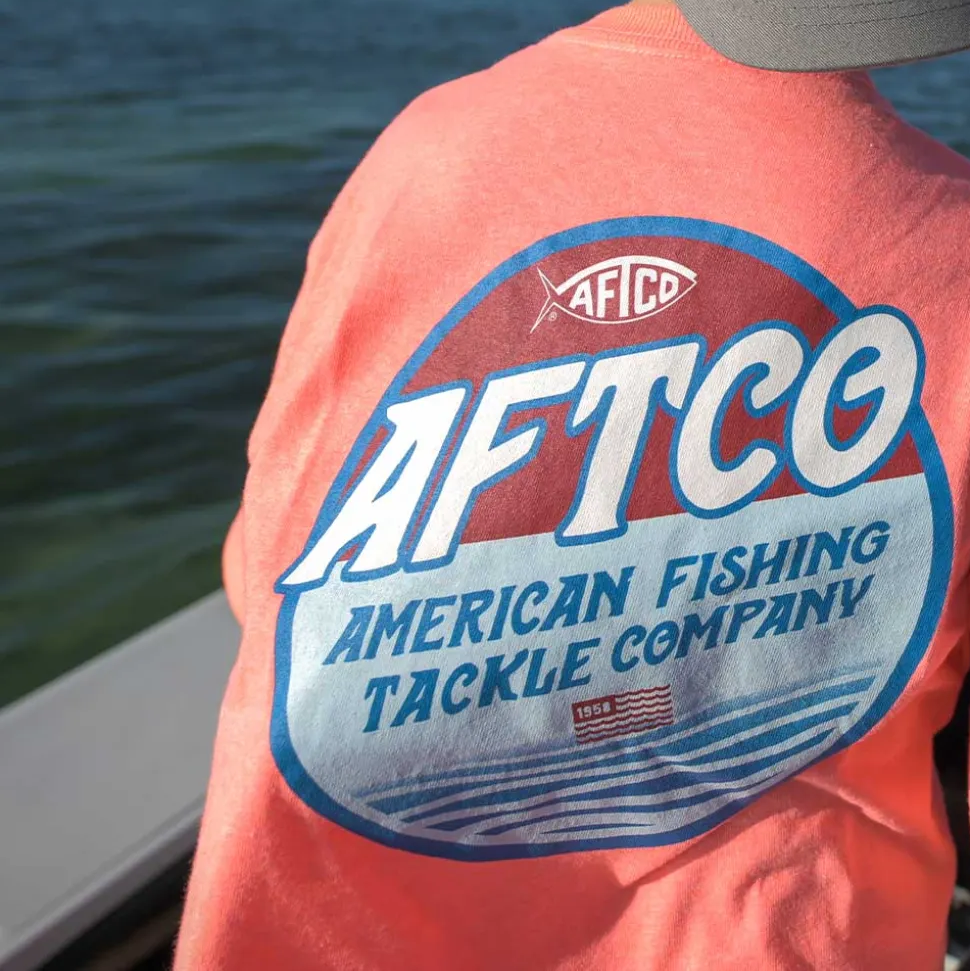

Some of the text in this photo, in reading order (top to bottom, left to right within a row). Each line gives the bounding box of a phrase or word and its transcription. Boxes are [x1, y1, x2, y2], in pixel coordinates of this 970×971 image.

[568, 256, 680, 318] AFTCO
[280, 311, 919, 586] AFTCO
[322, 520, 891, 665] AMERICAN FISHING
[362, 574, 876, 733] TACKLE COMPANY
[576, 701, 611, 719] 1958
